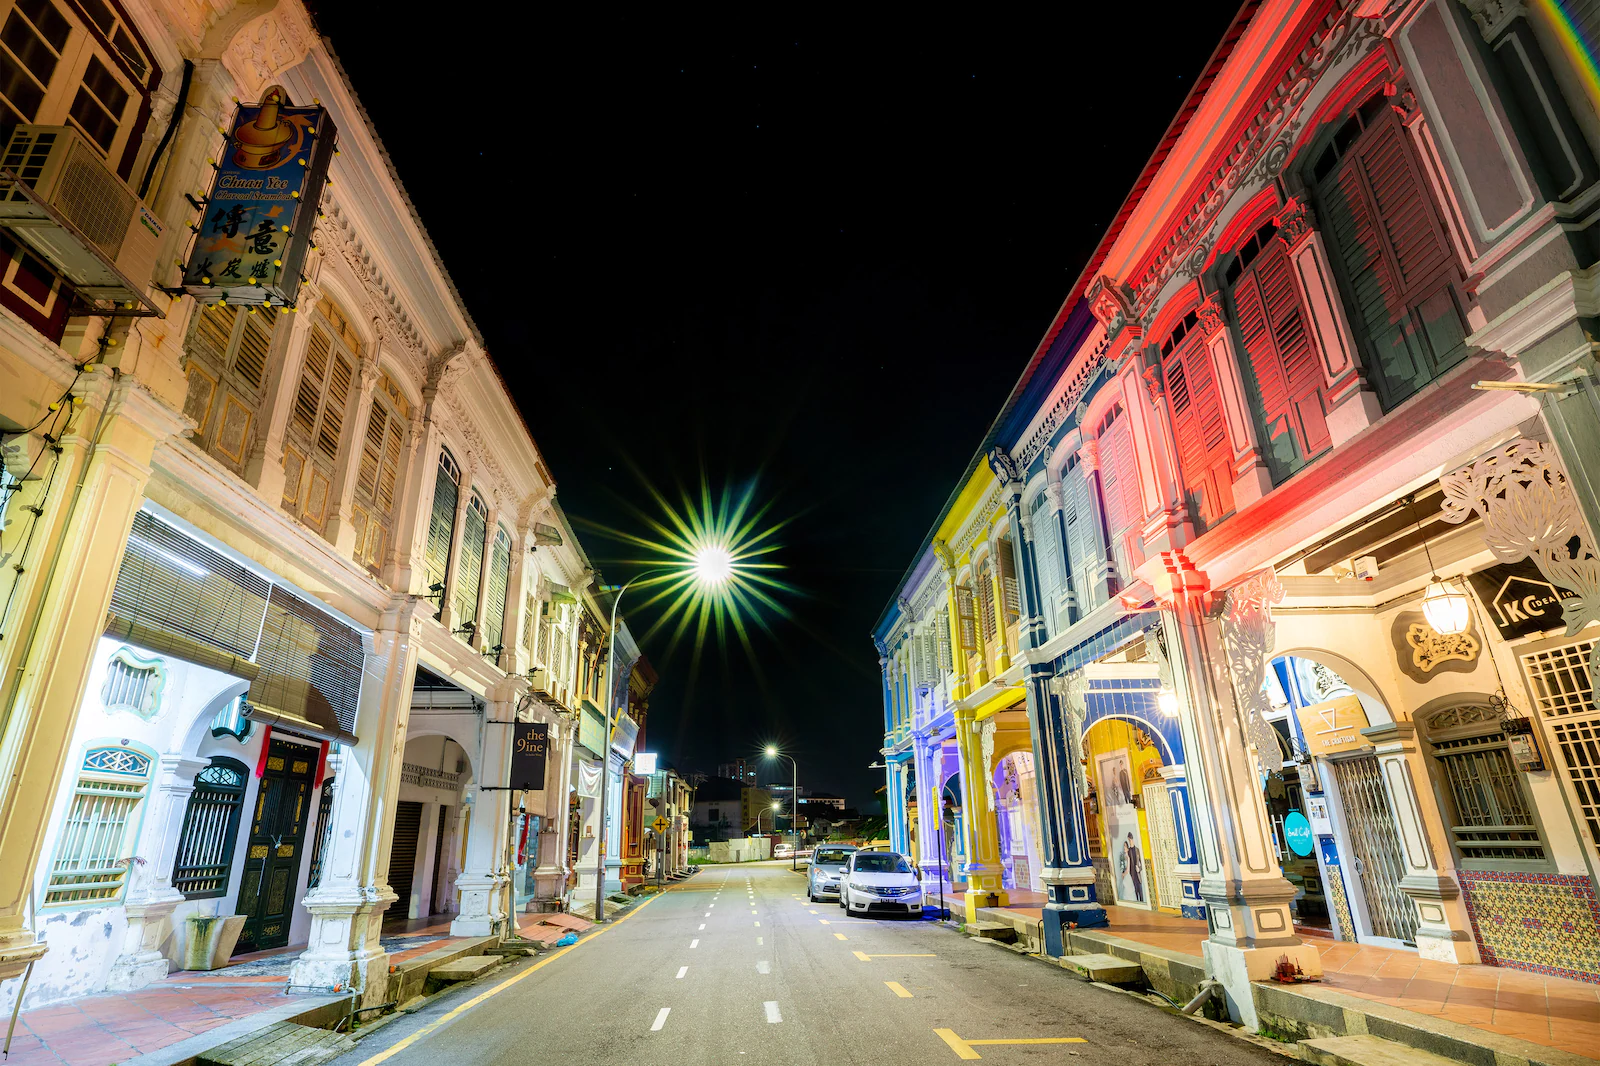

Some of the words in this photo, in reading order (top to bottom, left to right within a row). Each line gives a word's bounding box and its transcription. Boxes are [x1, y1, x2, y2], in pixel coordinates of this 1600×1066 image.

[219, 175, 264, 189] Chuan
[266, 176, 288, 189] Yee
[215, 190, 252, 200] Charcoal
[1532, 596, 1556, 608] IDEA
[527, 729, 544, 740] the
[517, 738, 543, 752] 9ine
[1321, 739, 1332, 747] THE
